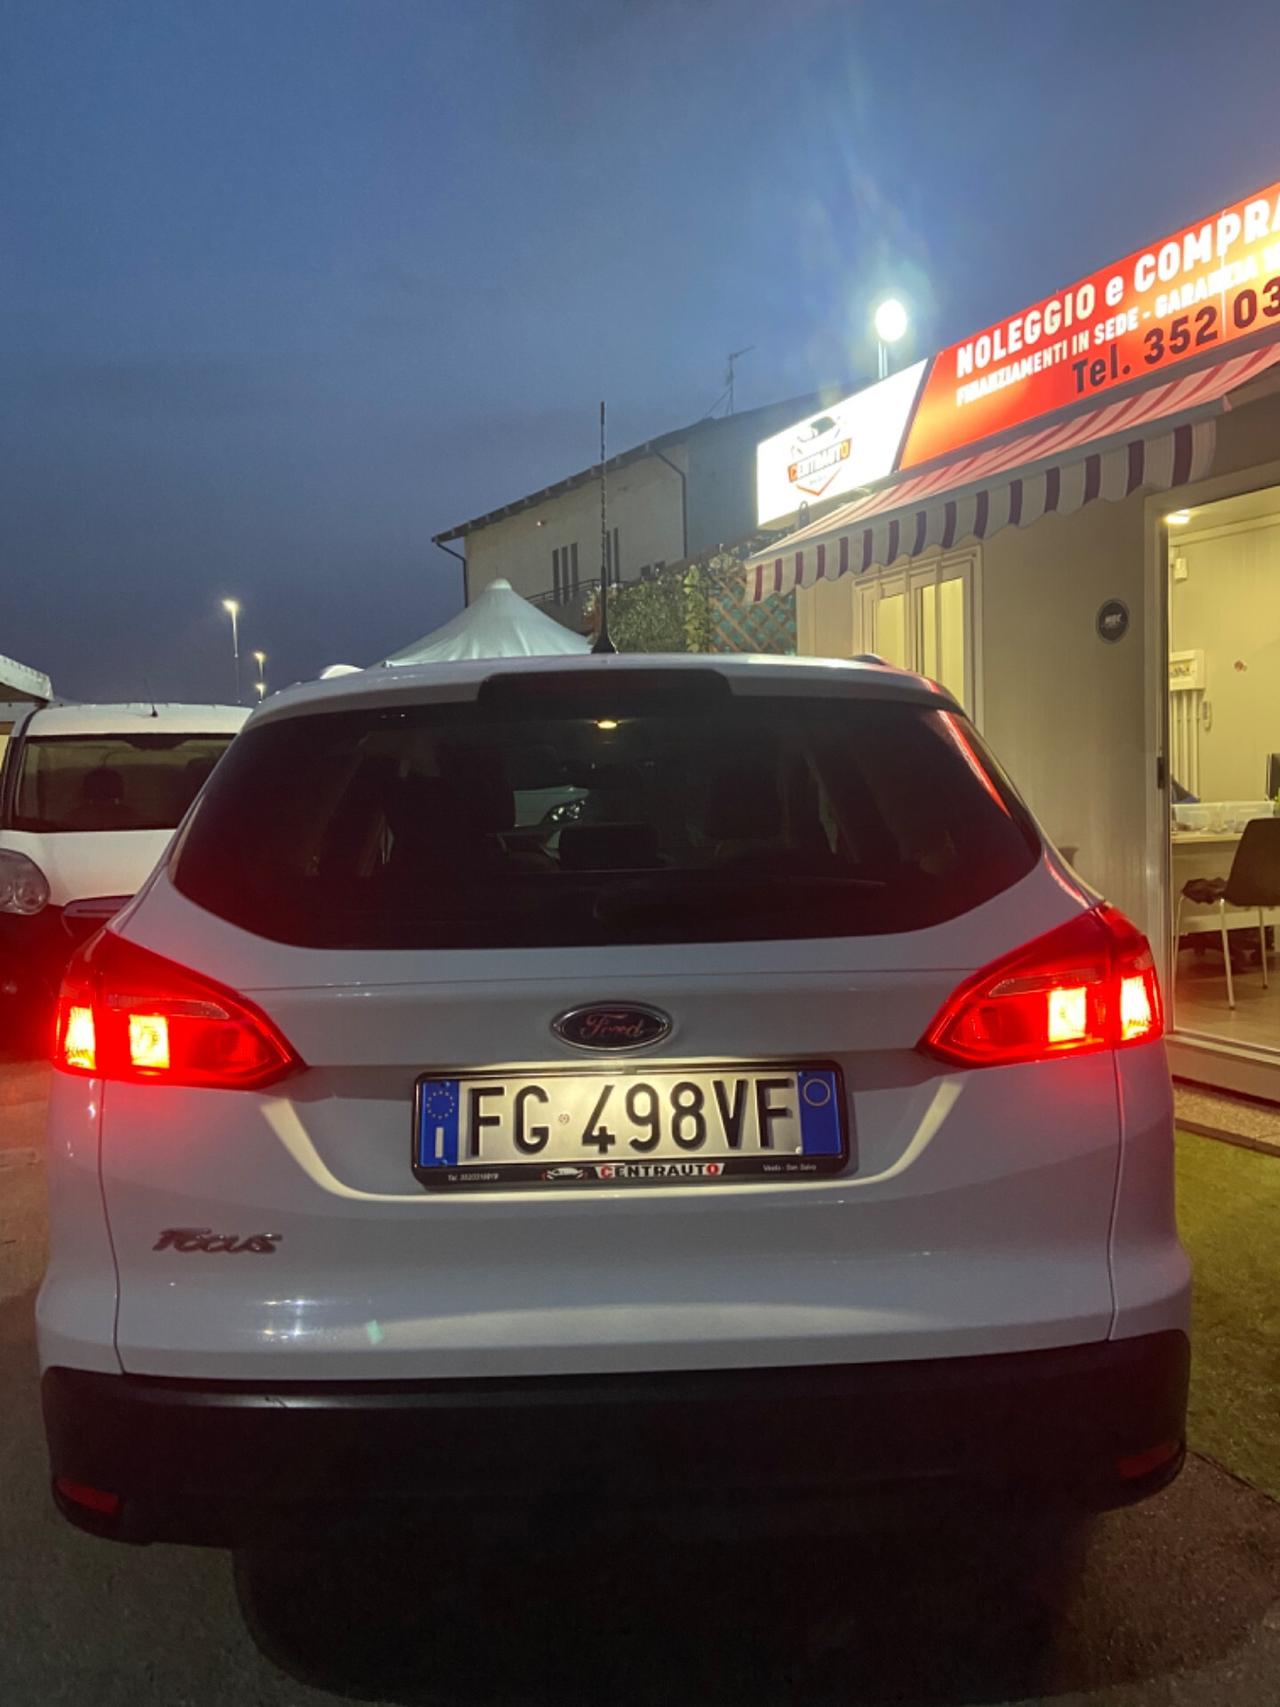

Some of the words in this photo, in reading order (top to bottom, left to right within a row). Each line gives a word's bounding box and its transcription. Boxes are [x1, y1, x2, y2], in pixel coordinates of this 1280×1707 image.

[956, 283, 1095, 378] NOLEGGIO
[1105, 275, 1124, 306] e
[956, 338, 1067, 407] FINANZIAMENTI
[1072, 330, 1089, 355] IN
[1094, 306, 1139, 345] SEDE
[1072, 344, 1131, 394] Tel.
[1143, 305, 1218, 364] 352
[580, 1013, 644, 1038] Ford
[469, 1086, 549, 1156] FG
[582, 1078, 794, 1154] 498VF
[600, 1163, 720, 1178] CENTRAUTO
[152, 1227, 282, 1254] Focus
